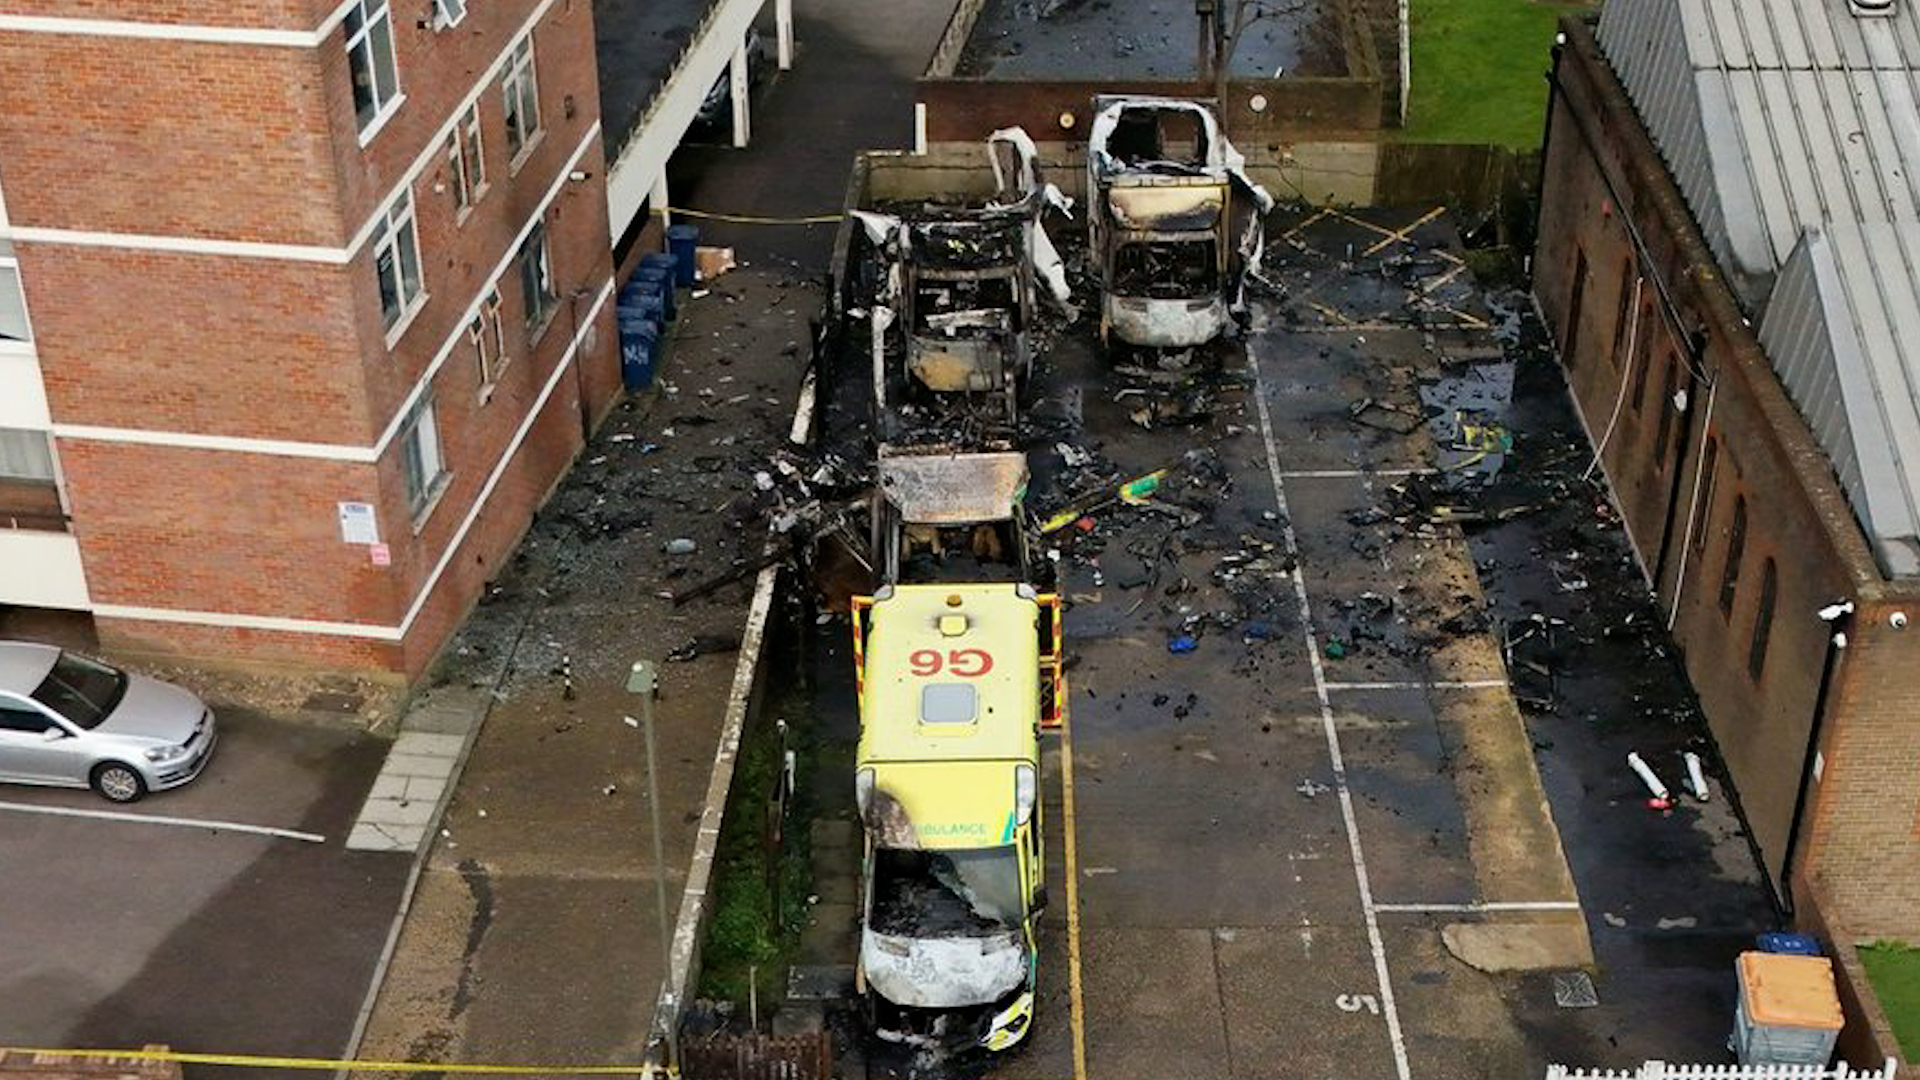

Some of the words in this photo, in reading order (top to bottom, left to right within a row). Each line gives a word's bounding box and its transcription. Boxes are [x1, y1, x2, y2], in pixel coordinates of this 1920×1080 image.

[910, 649, 993, 676] G6
[911, 823, 987, 836] BULANCE
[1335, 993, 1379, 1015] 5
